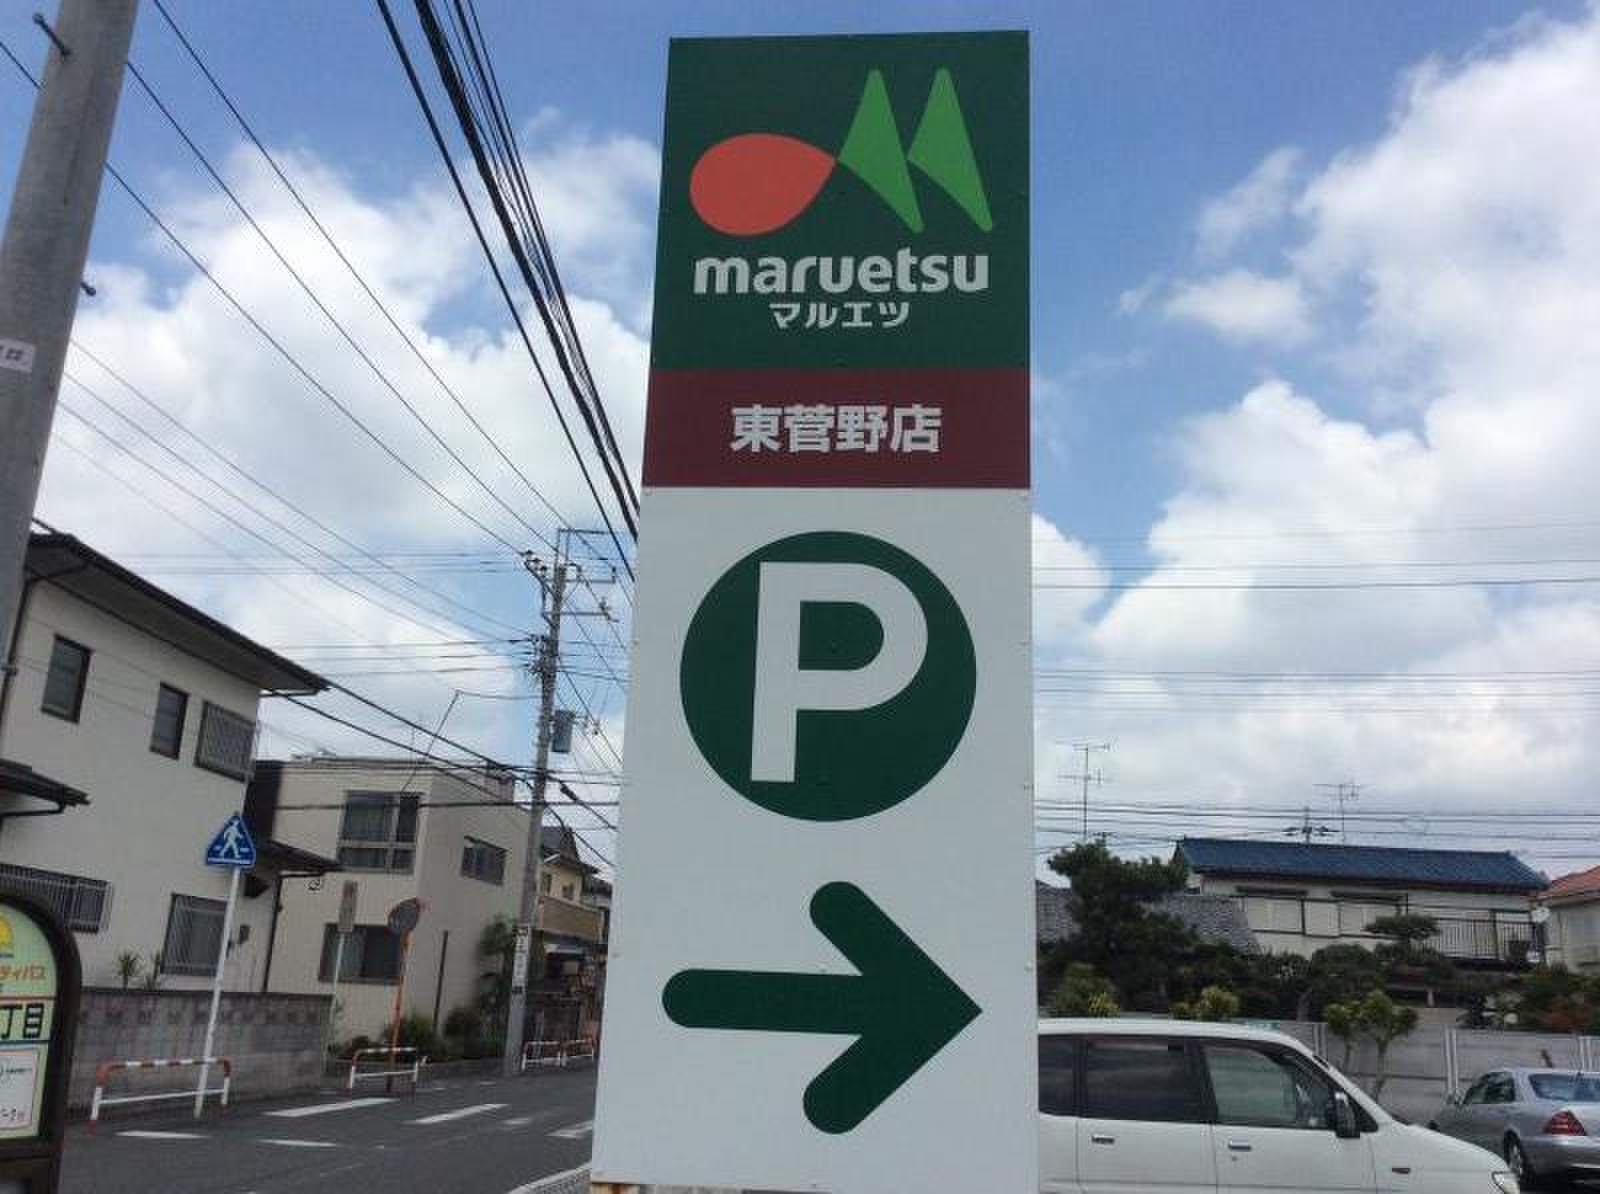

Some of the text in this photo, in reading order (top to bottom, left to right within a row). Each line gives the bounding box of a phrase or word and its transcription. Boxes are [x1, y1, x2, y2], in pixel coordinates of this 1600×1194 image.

[694, 247, 989, 296] maruetsu
[769, 301, 910, 329] マルエツ
[731, 403, 942, 454] 東菅野店
[751, 561, 929, 783] P
